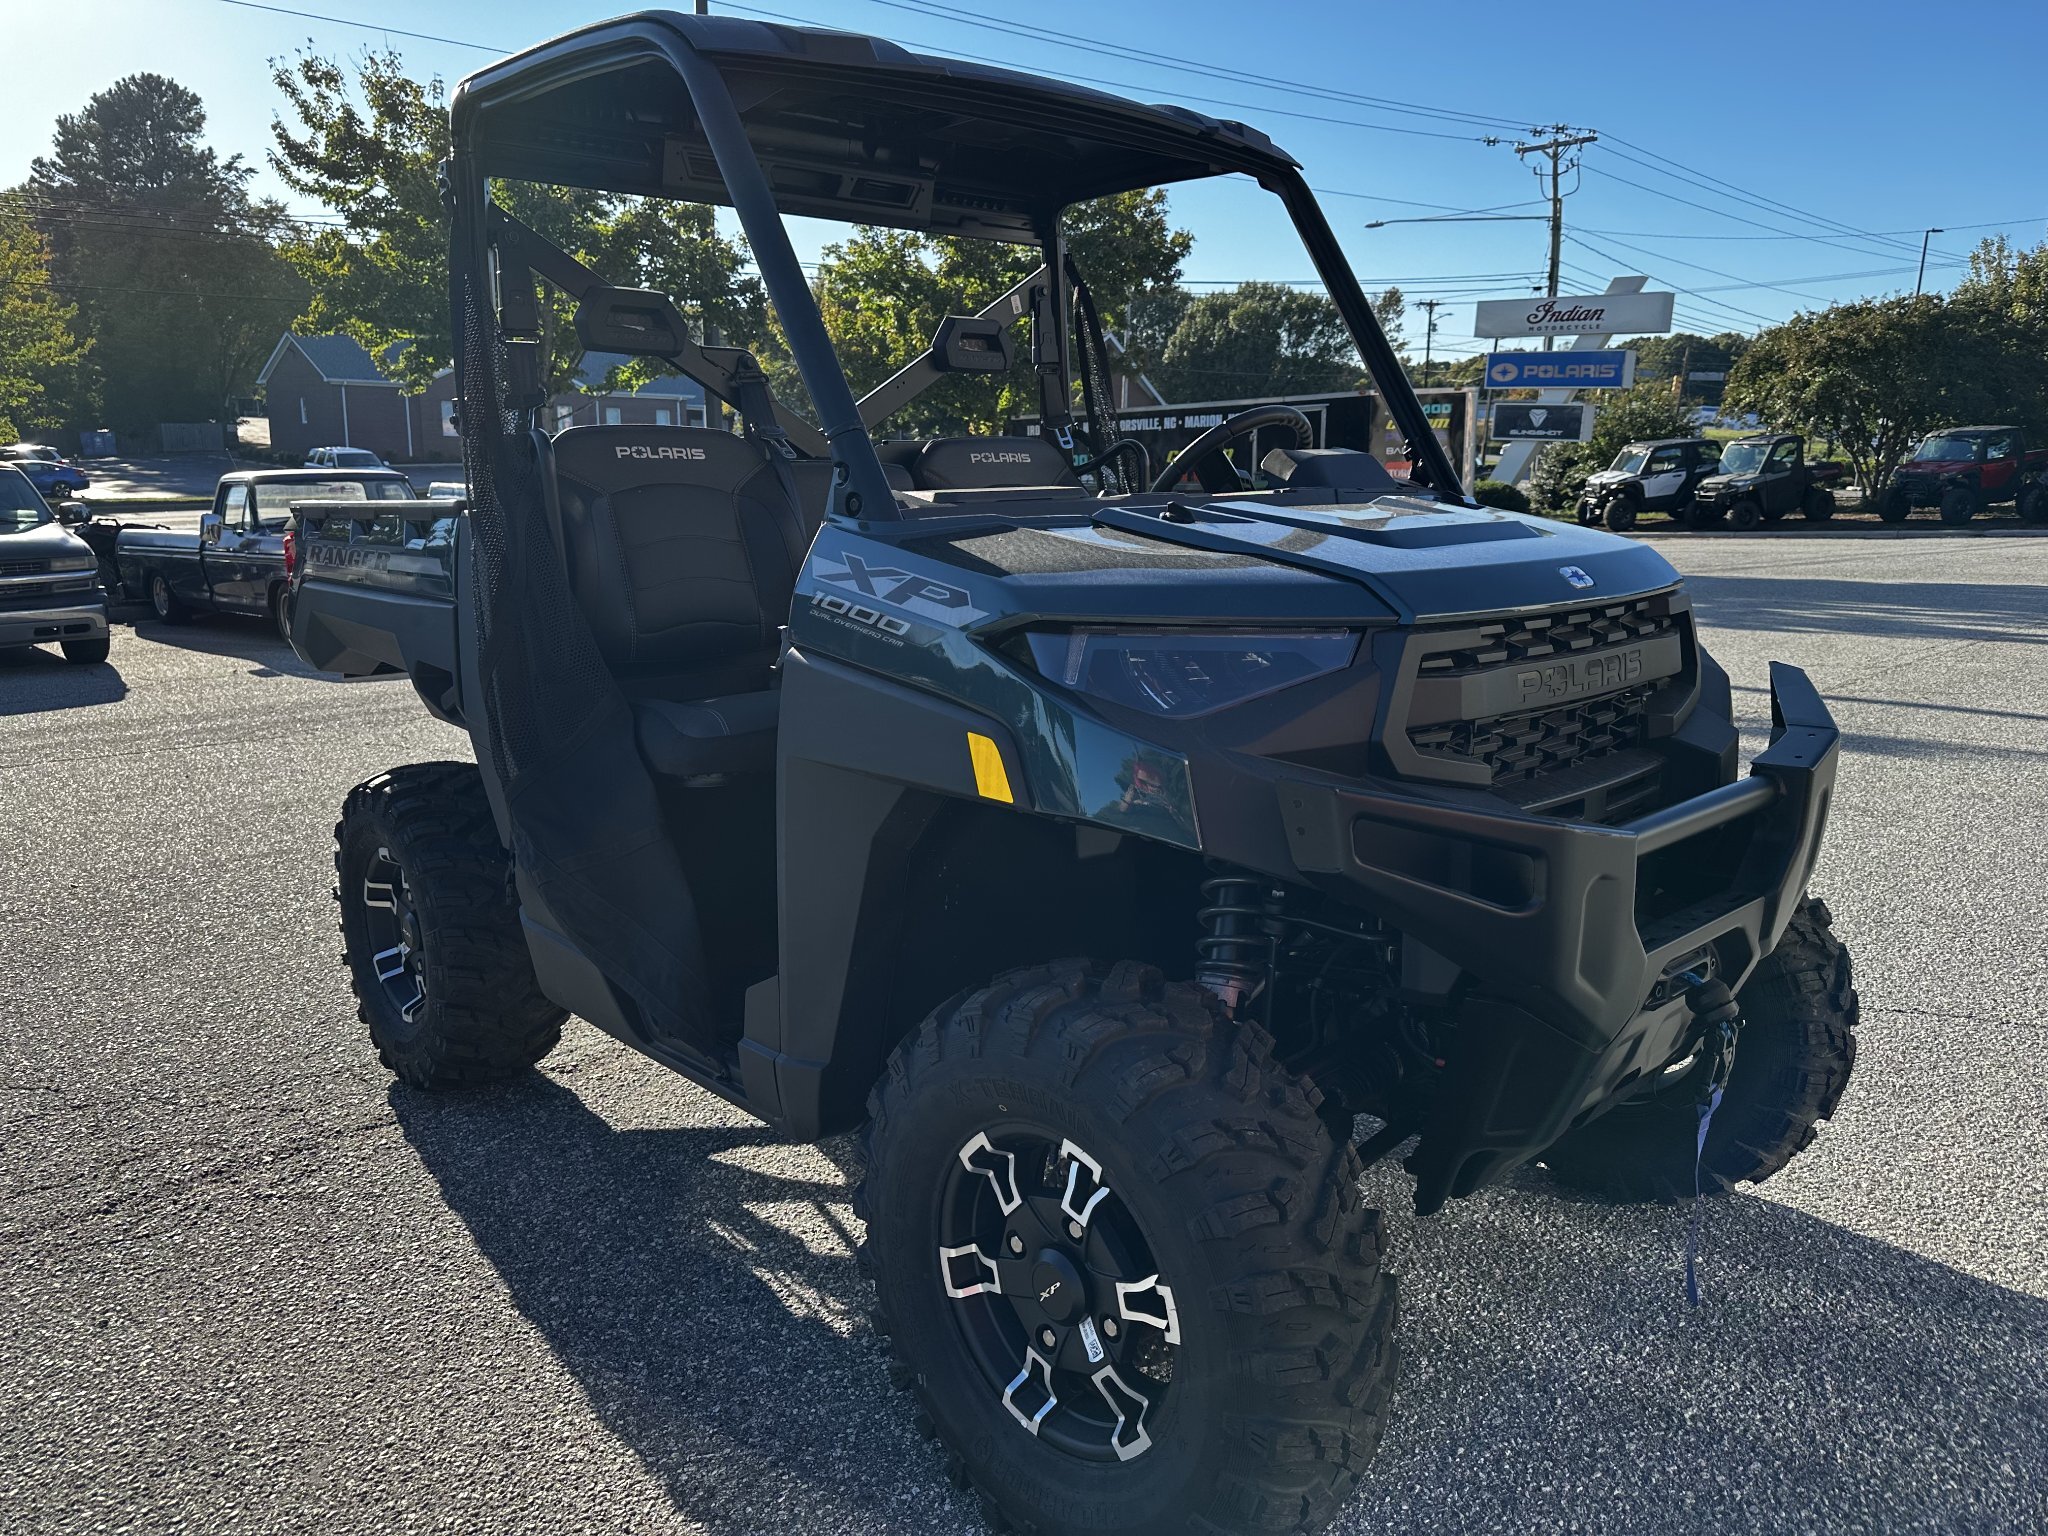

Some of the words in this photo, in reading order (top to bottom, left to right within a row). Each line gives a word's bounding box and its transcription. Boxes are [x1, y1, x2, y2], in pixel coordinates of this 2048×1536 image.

[1526, 300, 1605, 324] Indian
[1528, 324, 1601, 332] MOTORCYCLE
[1523, 364, 1616, 378] POLARIS
[615, 446, 706, 460] POLARIS
[970, 452, 1031, 464] POLARIS
[306, 543, 391, 572] RANGER
[813, 551, 973, 609] XP
[811, 590, 912, 636] 1000
[809, 609, 832, 622] DUAL
[833, 617, 882, 639] OVERHEAD
[882, 635, 904, 647] CAM
[1516, 649, 1643, 704] POLARIS
[1039, 1281, 1061, 1303] XP
